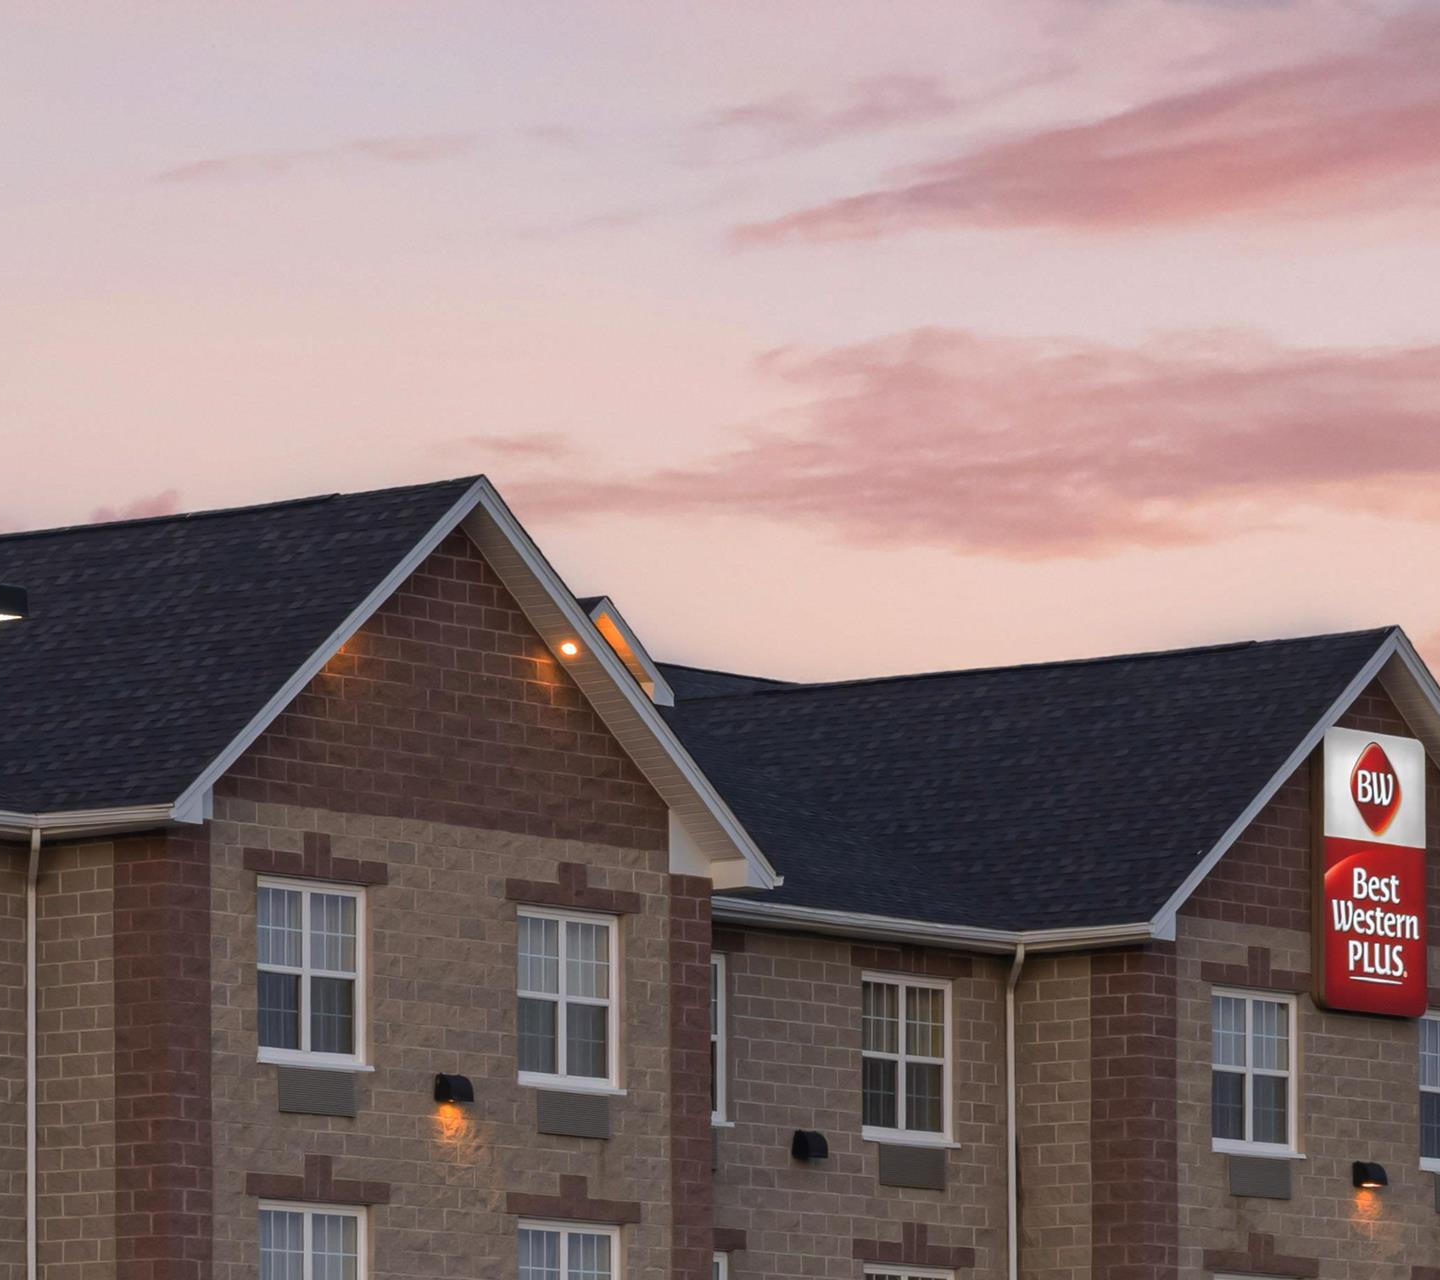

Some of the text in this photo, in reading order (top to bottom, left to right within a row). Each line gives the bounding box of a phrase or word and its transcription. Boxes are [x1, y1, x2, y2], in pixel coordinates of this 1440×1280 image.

[1357, 770, 1393, 805] BW
[1353, 867, 1400, 904] Best
[1332, 899, 1419, 940] Western
